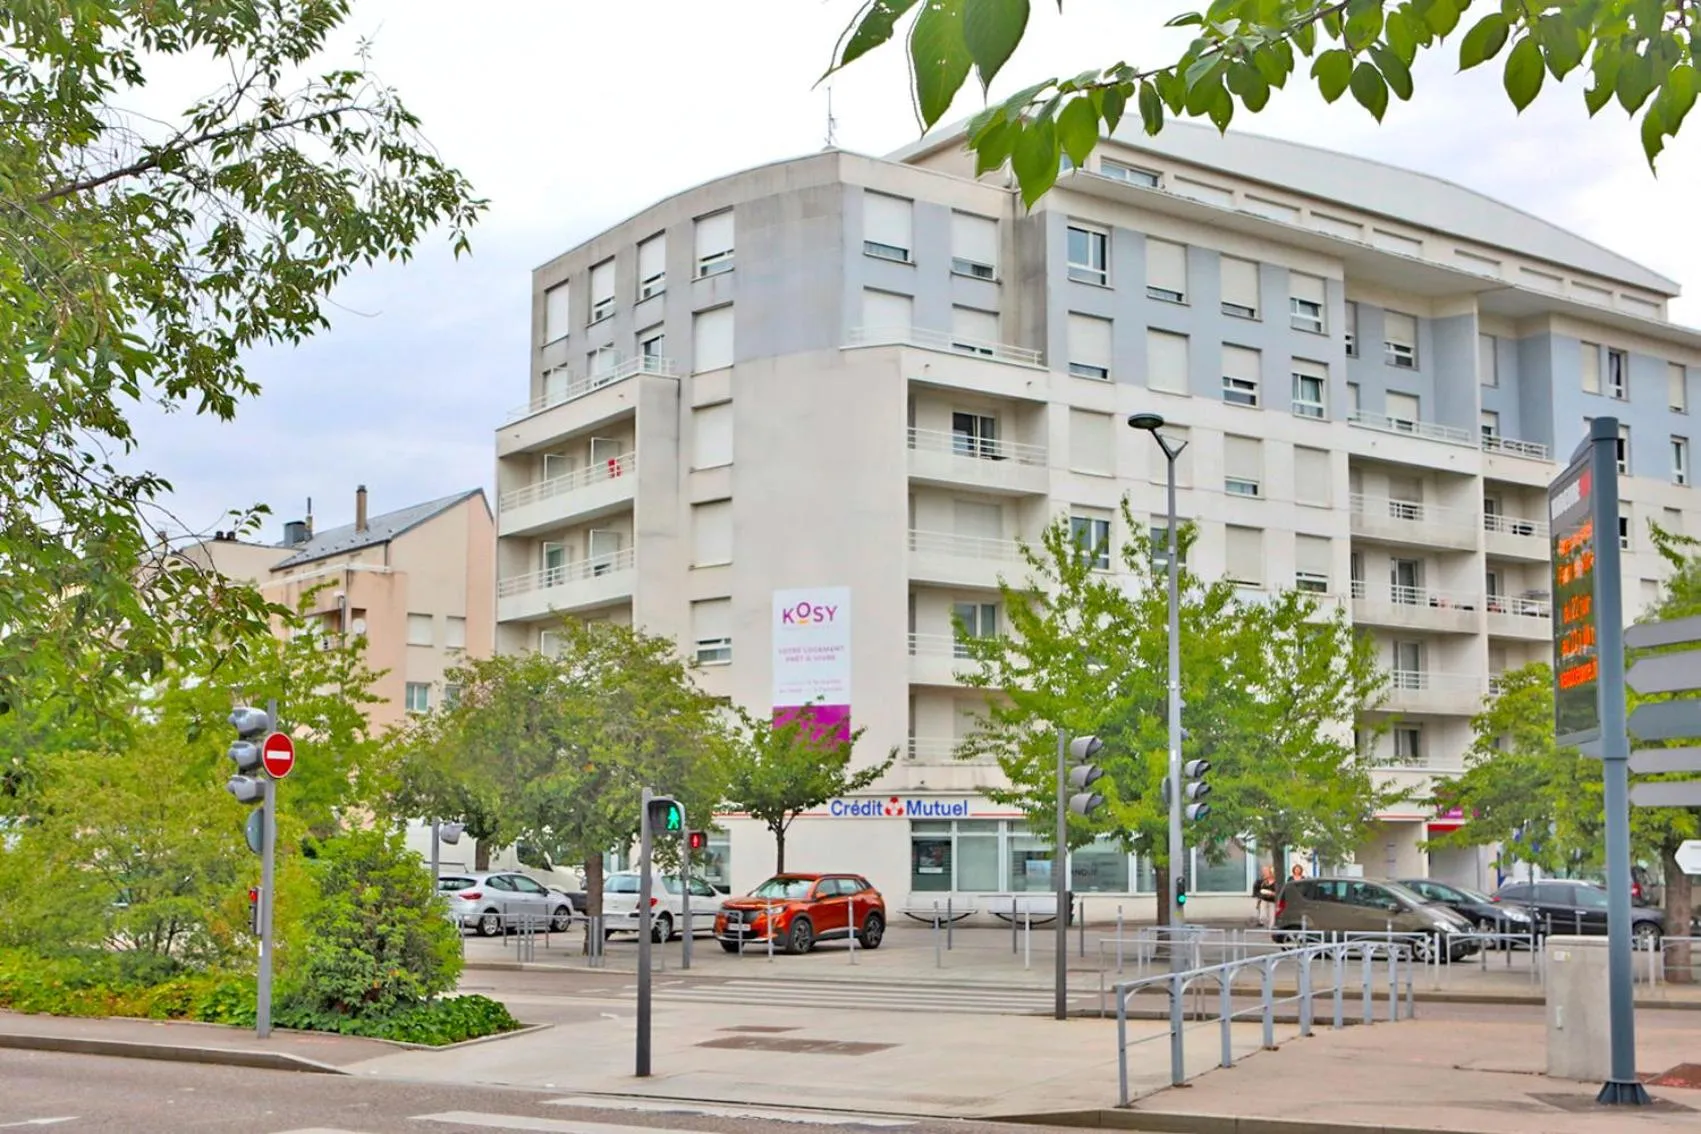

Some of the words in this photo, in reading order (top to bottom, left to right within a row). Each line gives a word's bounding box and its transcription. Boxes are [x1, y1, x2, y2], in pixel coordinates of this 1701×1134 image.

[783, 602, 838, 624] KOSY
[831, 799, 882, 816] Crédit
[906, 799, 967, 816] Mutuel
